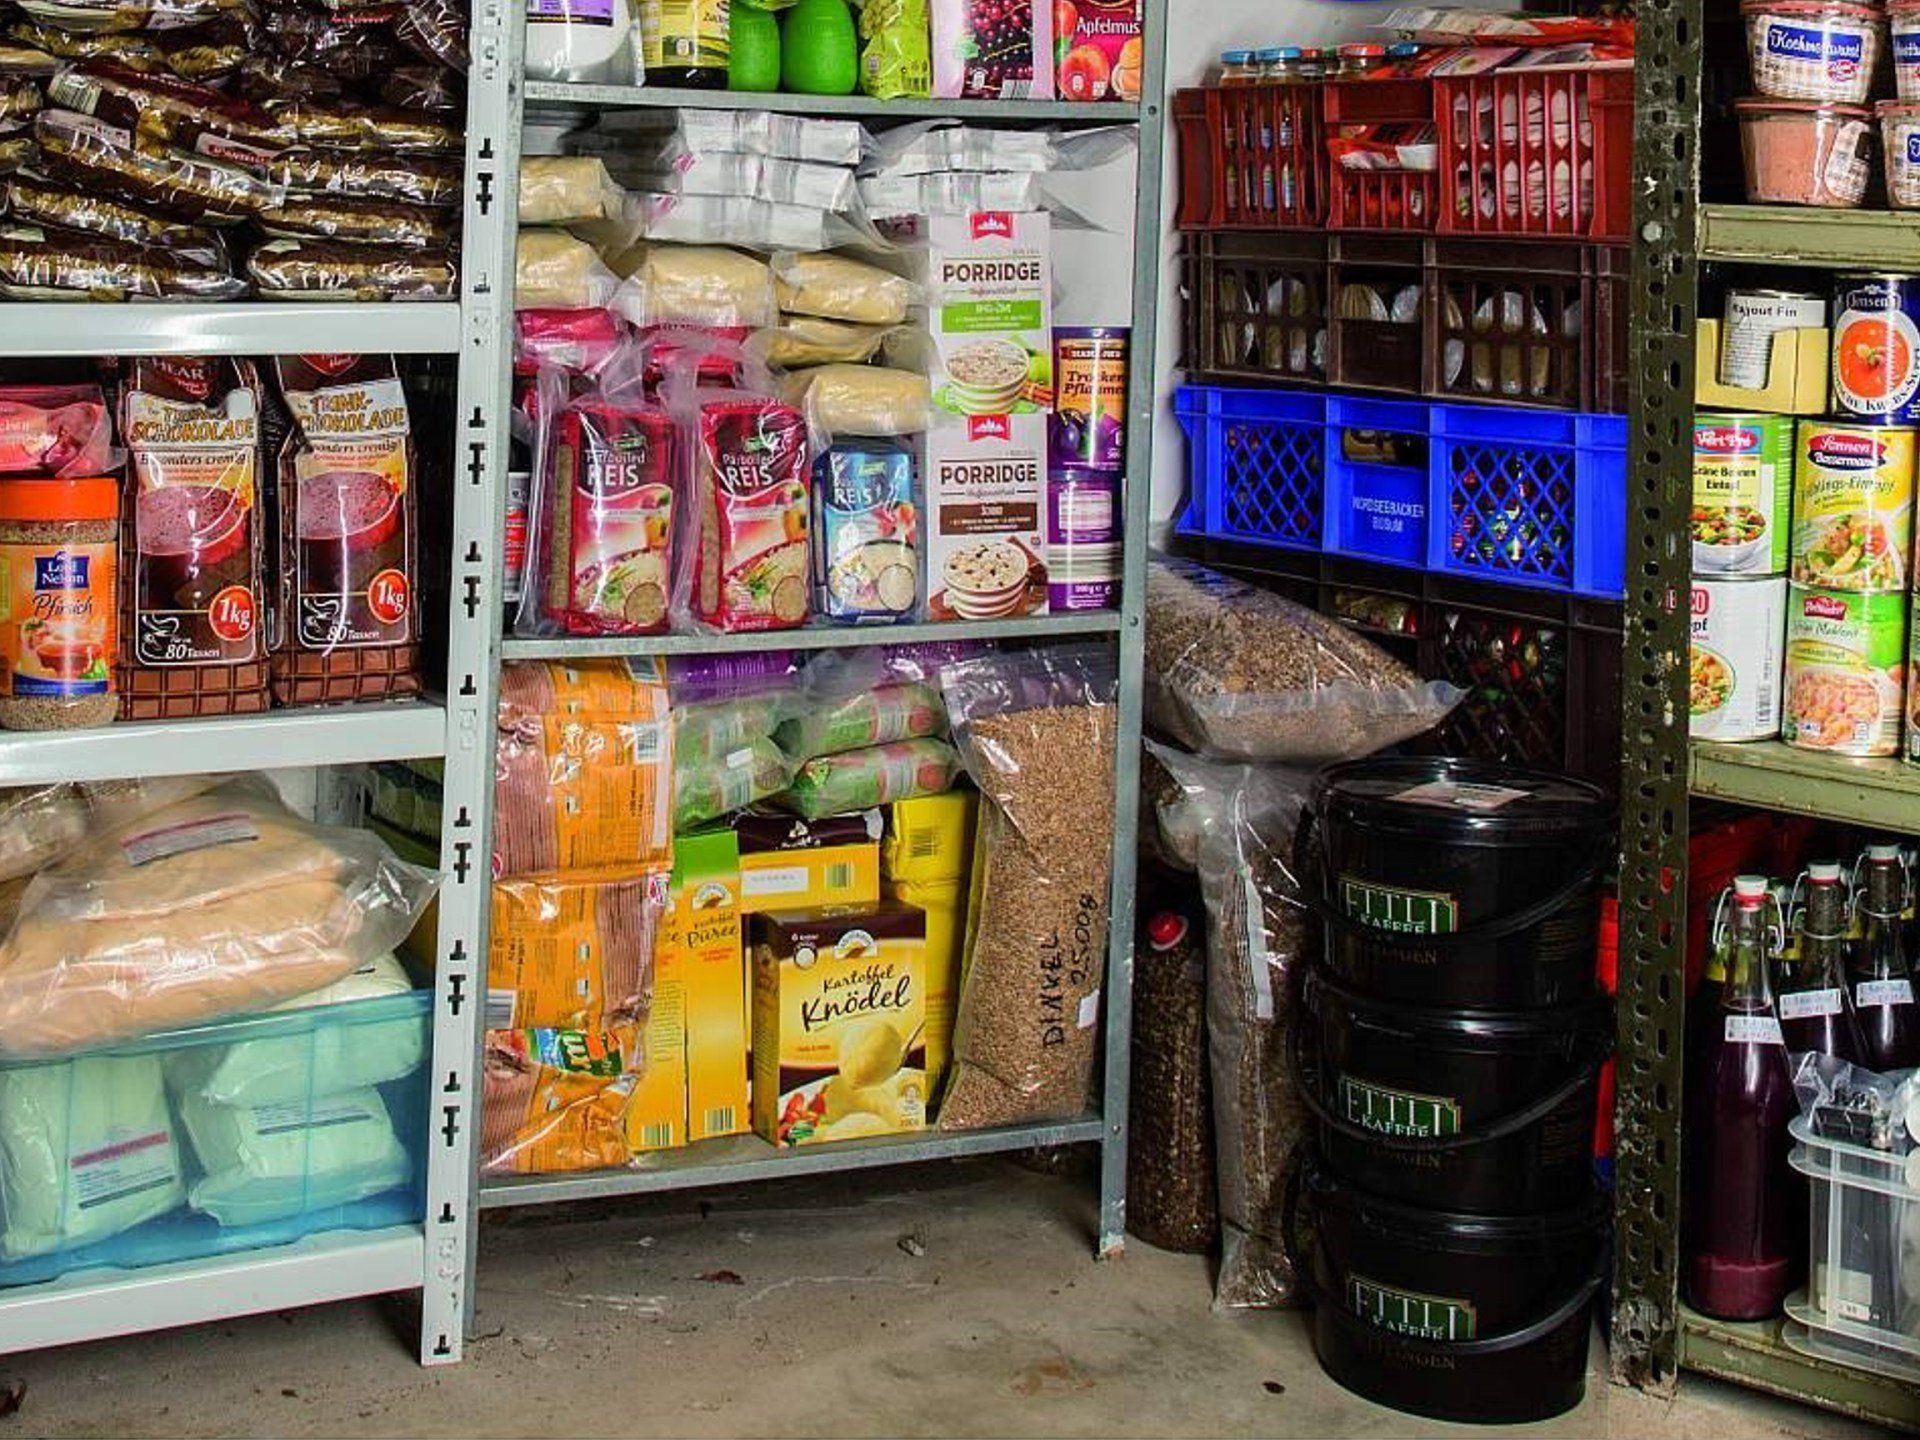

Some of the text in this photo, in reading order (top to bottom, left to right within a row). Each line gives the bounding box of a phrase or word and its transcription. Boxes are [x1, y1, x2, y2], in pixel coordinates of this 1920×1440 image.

[1076, 16, 1141, 37] Apfelmus
[943, 262, 1040, 282] PORRIDGE
[1776, 306, 1797, 318] Fin
[1066, 371, 1125, 382] Troken
[130, 419, 255, 443] SCHOKOLADE
[299, 407, 406, 433] CHOKOLADE
[587, 463, 639, 487] REIS
[725, 465, 774, 488] REIS
[941, 463, 1038, 485] PORRIDGE
[834, 487, 873, 505] REIS
[47, 560, 78, 573] Lod
[42, 573, 84, 585] Nelon
[378, 581, 405, 613] 1kg
[219, 599, 251, 632] 1kg
[348, 630, 380, 640] Tassen
[165, 643, 220, 660] 80 Tassen
[823, 963, 896, 993] Kartoffel
[1039, 928, 1064, 1048] DINKEL
[801, 975, 911, 1033] Knödel
[1346, 1082, 1440, 1137] ETTLI
